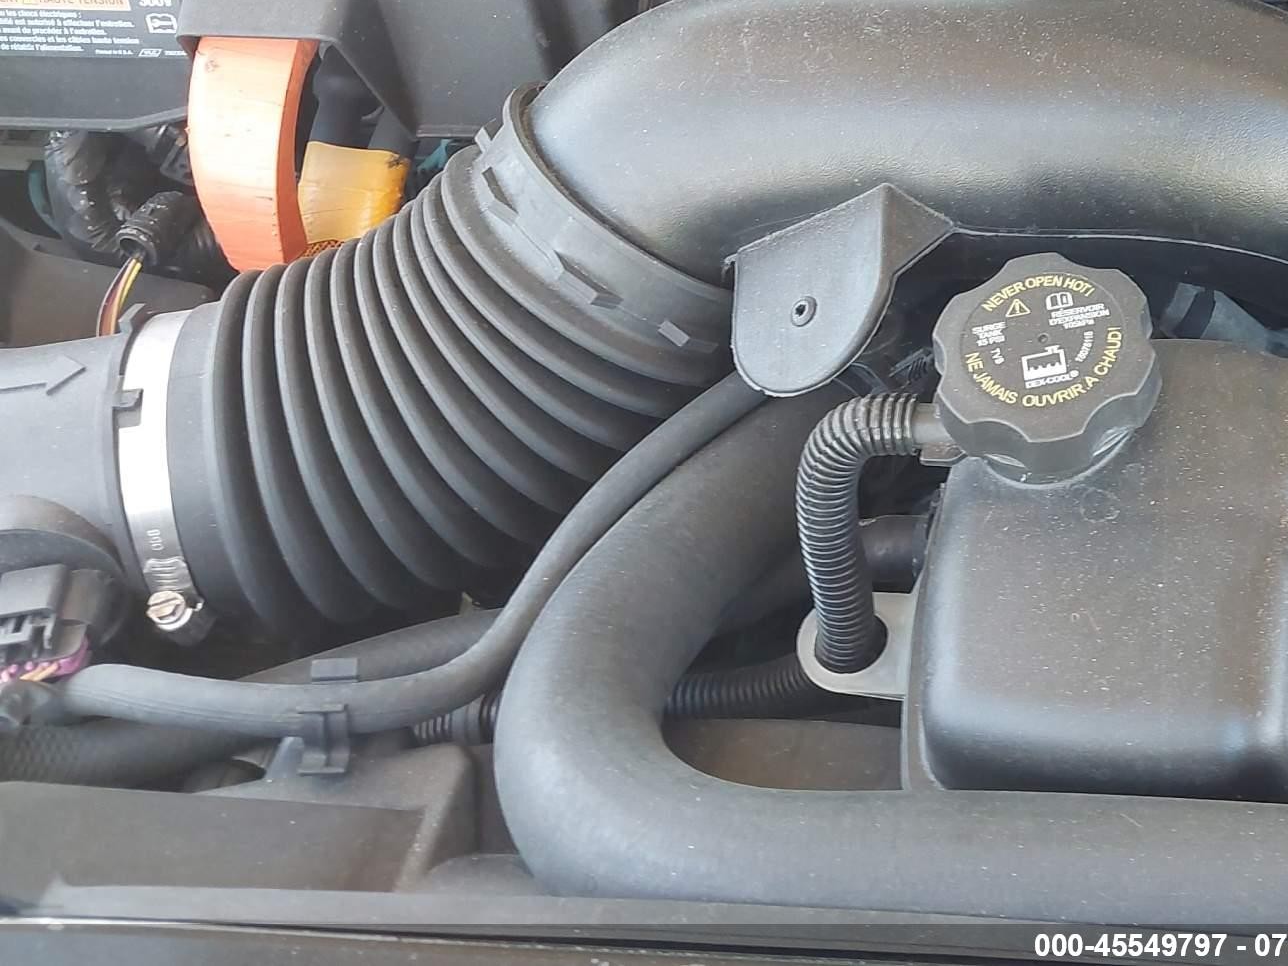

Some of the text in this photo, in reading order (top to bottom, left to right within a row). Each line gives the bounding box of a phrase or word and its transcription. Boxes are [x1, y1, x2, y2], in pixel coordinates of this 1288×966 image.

[981, 281, 1026, 311] NEVER
[1025, 275, 1063, 289] OPEN
[971, 321, 1006, 334] SURGE
[964, 352, 984, 372] NE
[973, 372, 1018, 404] JAMAIS
[1022, 383, 1087, 406] OUVRIR
